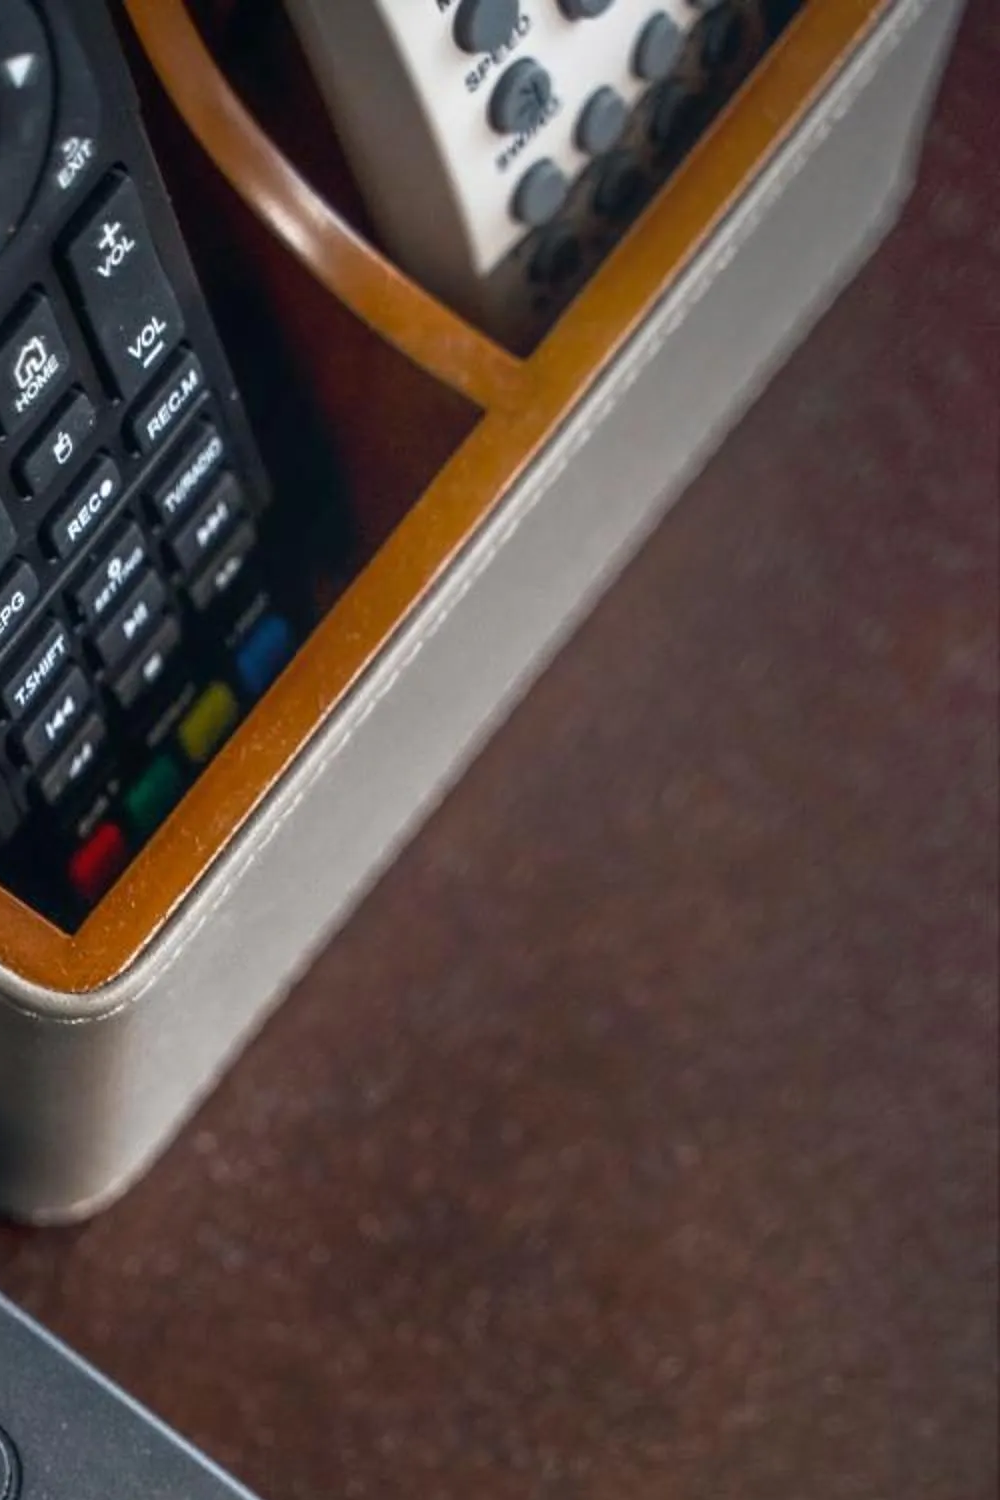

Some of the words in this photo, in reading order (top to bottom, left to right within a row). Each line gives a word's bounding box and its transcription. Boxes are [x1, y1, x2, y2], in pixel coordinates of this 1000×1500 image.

[56, 139, 92, 189] EXIT
[96, 235, 136, 278] VOL
[127, 316, 167, 359] VOL
[15, 353, 60, 413] HOME
[146, 369, 199, 440] REC.M
[13, 633, 65, 706] T.SHIFT
